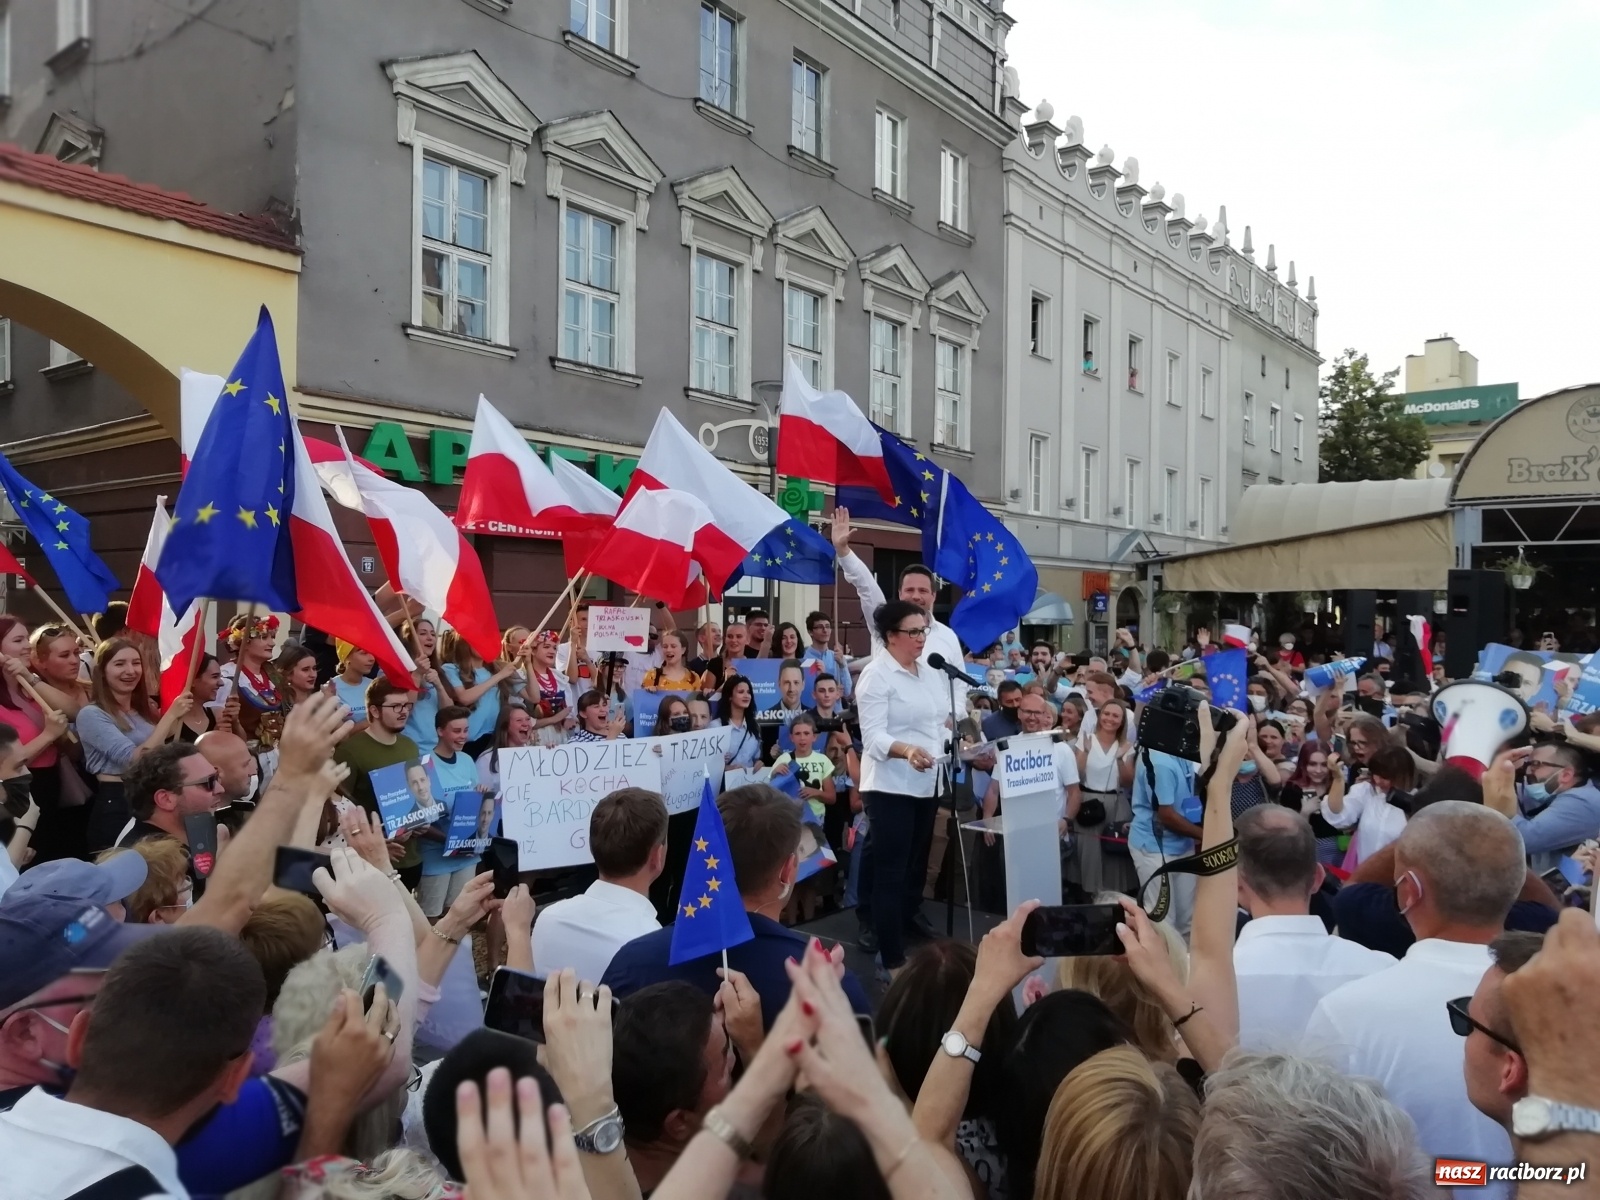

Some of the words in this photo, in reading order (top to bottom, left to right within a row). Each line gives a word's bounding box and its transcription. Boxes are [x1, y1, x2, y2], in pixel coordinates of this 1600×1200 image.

[1404, 399, 1479, 415] McDonald's
[754, 435, 769, 447] 1953
[362, 421, 639, 496] APK
[1508, 445, 1600, 484] BraX'
[670, 735, 725, 762] TRZASK
[1006, 748, 1052, 773] Racibórz
[505, 783, 531, 803] CIĘ
[387, 802, 445, 830] TRZASKOWSKI
[524, 798, 598, 828] BARD
[448, 837, 492, 849] TRZASKOWSKI
